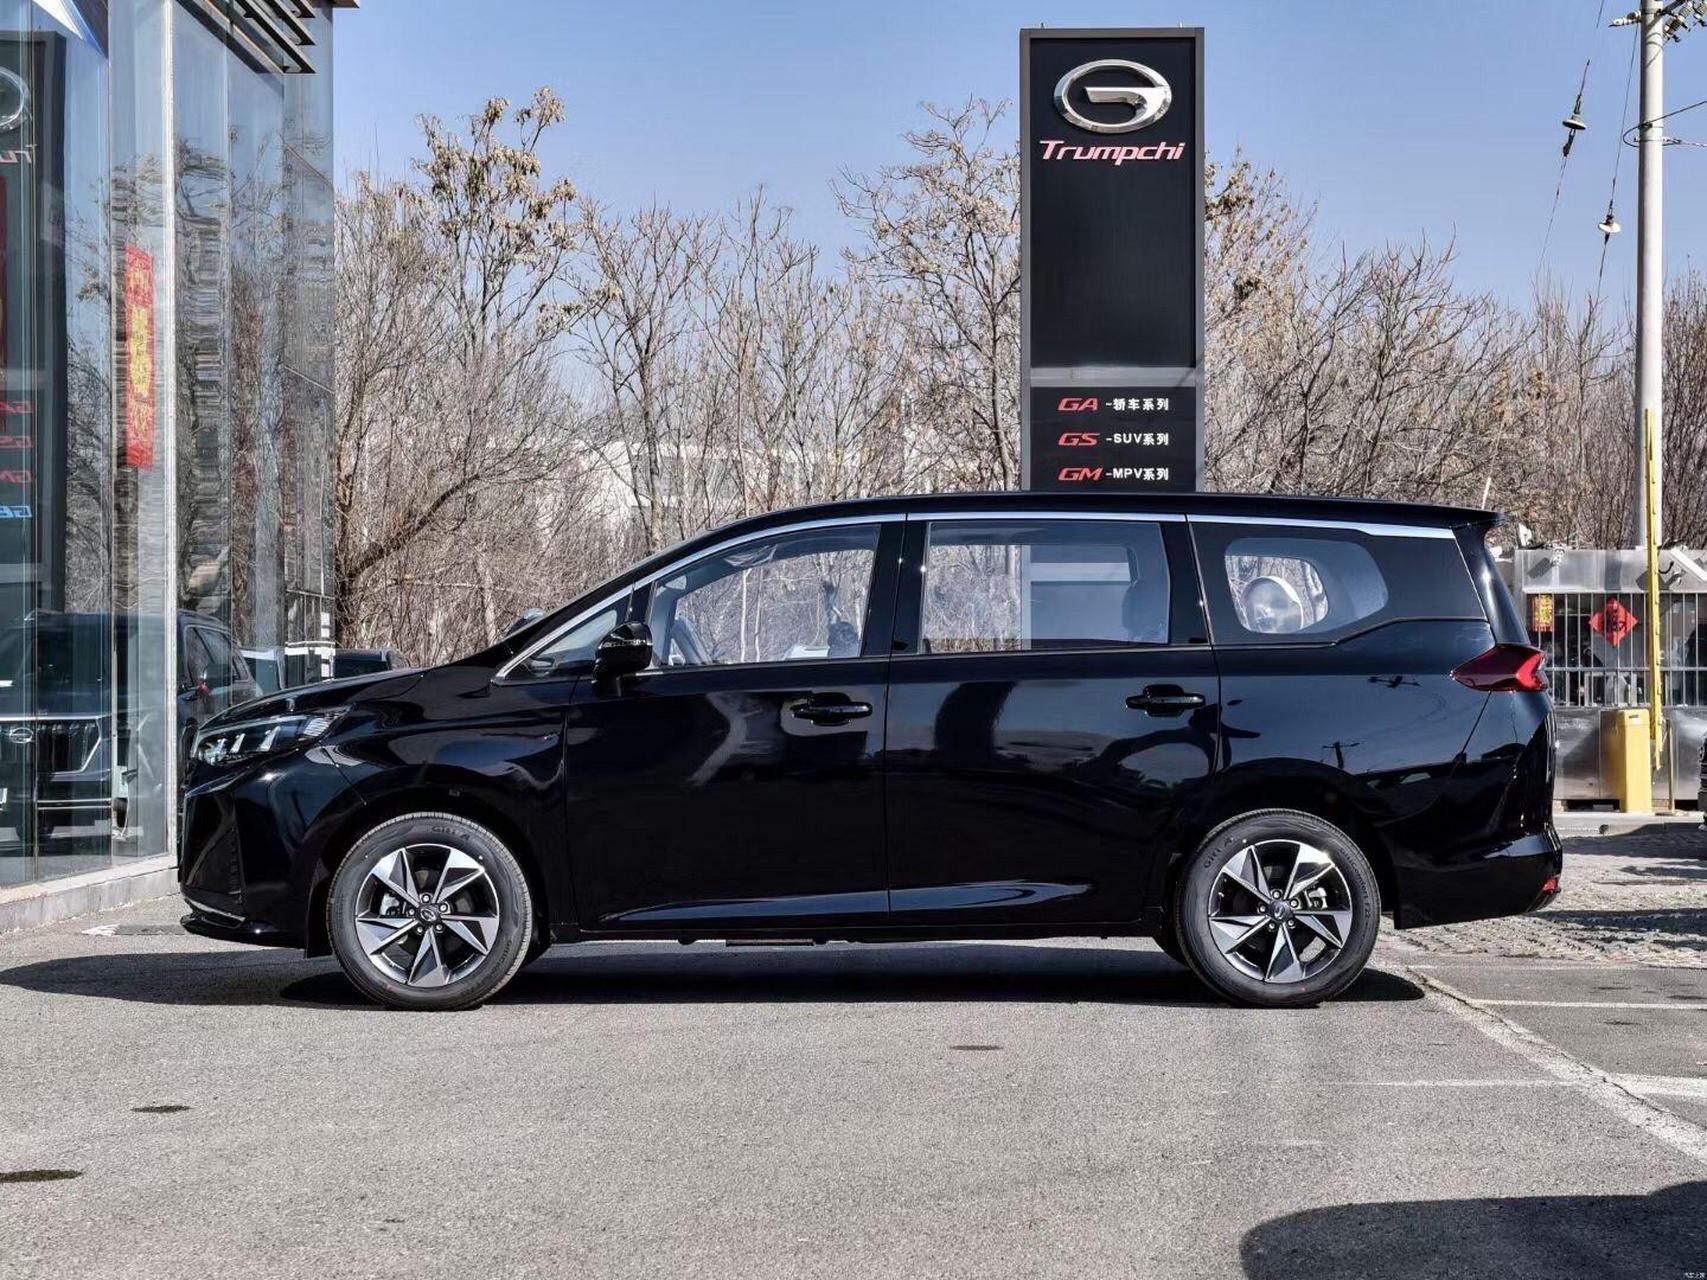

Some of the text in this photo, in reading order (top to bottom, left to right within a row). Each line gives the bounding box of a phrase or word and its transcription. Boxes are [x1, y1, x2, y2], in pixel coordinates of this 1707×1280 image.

[1039, 140, 1186, 166] Trumpchi
[1057, 397, 1099, 411] GA
[1058, 432, 1101, 446] GS
[1057, 466, 1103, 481] GM
